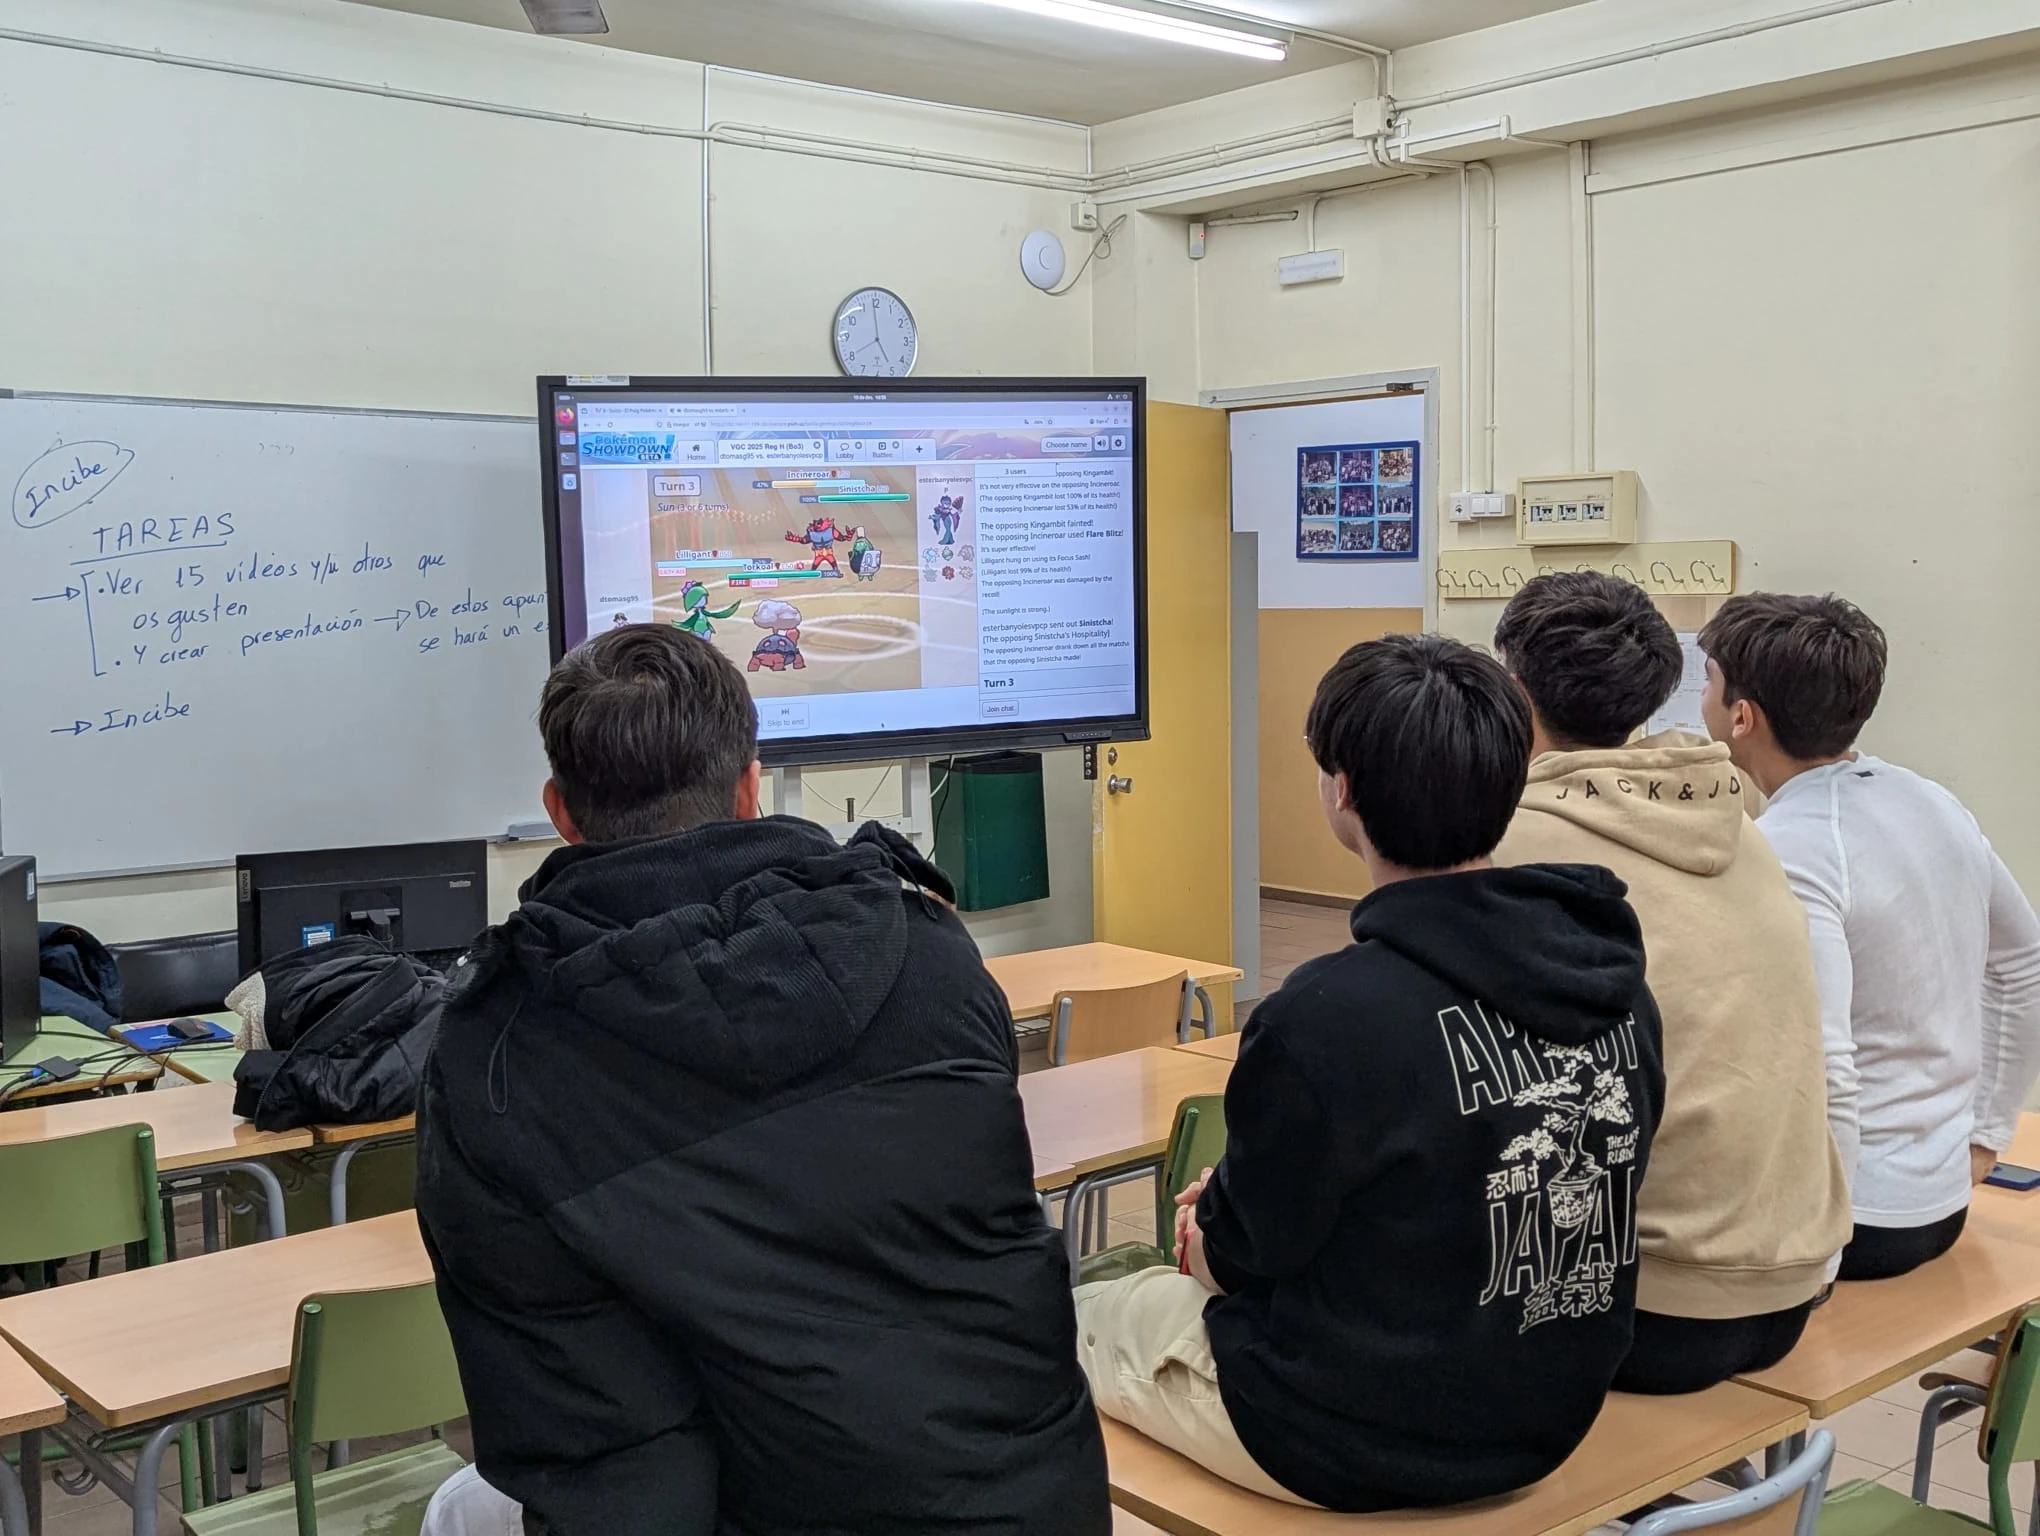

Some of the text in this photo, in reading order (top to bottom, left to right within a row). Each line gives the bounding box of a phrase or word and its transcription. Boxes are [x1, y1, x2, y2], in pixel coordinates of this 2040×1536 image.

[872, 298, 880, 309] 12
[848, 316, 857, 326] 10
[898, 318, 904, 328] 2
[903, 337, 909, 347] 3
[849, 351, 855, 361] 8
[860, 365, 866, 374] 7
[889, 367, 895, 376] 5
[595, 433, 657, 445] Pokémon
[764, 443, 778, 452] Reg
[786, 442, 804, 451] (Bo3)
[1045, 441, 1070, 449] Choose
[835, 452, 855, 461] Lobby
[787, 471, 830, 479] Incineroar
[26, 456, 108, 518] Incibe
[659, 481, 695, 491] Turn 3
[839, 485, 876, 493] Sinistcha
[980, 494, 993, 502] (The
[994, 494, 1022, 502] opposing
[1023, 493, 1053, 501] Kingambit
[657, 502, 675, 512] Sun
[705, 503, 729, 512] turns)
[980, 506, 993, 514] (The
[981, 519, 1094, 531] The opposing Kingambit fainted!
[93, 512, 235, 553] TAREAS
[981, 529, 1124, 542] The opposing Incineroar used Flare Blitz!
[991, 546, 1008, 554] super
[676, 551, 711, 560] Lilligant
[981, 557, 1005, 565] Lilligant
[1006, 556, 1021, 564] hung
[175, 564, 205, 588] 15
[352, 541, 393, 574] otros
[417, 553, 447, 578] que
[743, 563, 774, 571] Torkoal
[994, 579, 1021, 587] opposing
[1066, 576, 1094, 584] damaged
[415, 587, 548, 620] De estos apun
[996, 607, 1020, 615] sunlight
[133, 592, 248, 644] os gusten
[1049, 621, 1064, 629] sent
[1066, 620, 1078, 628] out
[1079, 618, 1113, 627] Sinistcha!
[159, 644, 210, 664] crear
[241, 608, 363, 657] presentación
[419, 636, 440, 654] se
[454, 624, 490, 647] hará
[503, 625, 521, 638] un
[1000, 635, 1033, 644] opposing
[1034, 632, 1070, 640] Sinistcha's
[995, 647, 1023, 655] opposing
[1008, 657, 1036, 665] opposing
[983, 678, 1014, 688] Turn 3
[98, 690, 191, 732] Incibe
[986, 705, 1000, 713] Join
[767, 719, 782, 728] Skip
[240, 872, 249, 899] Lenovo
[1486, 1160, 1540, 1200] 忍耐
